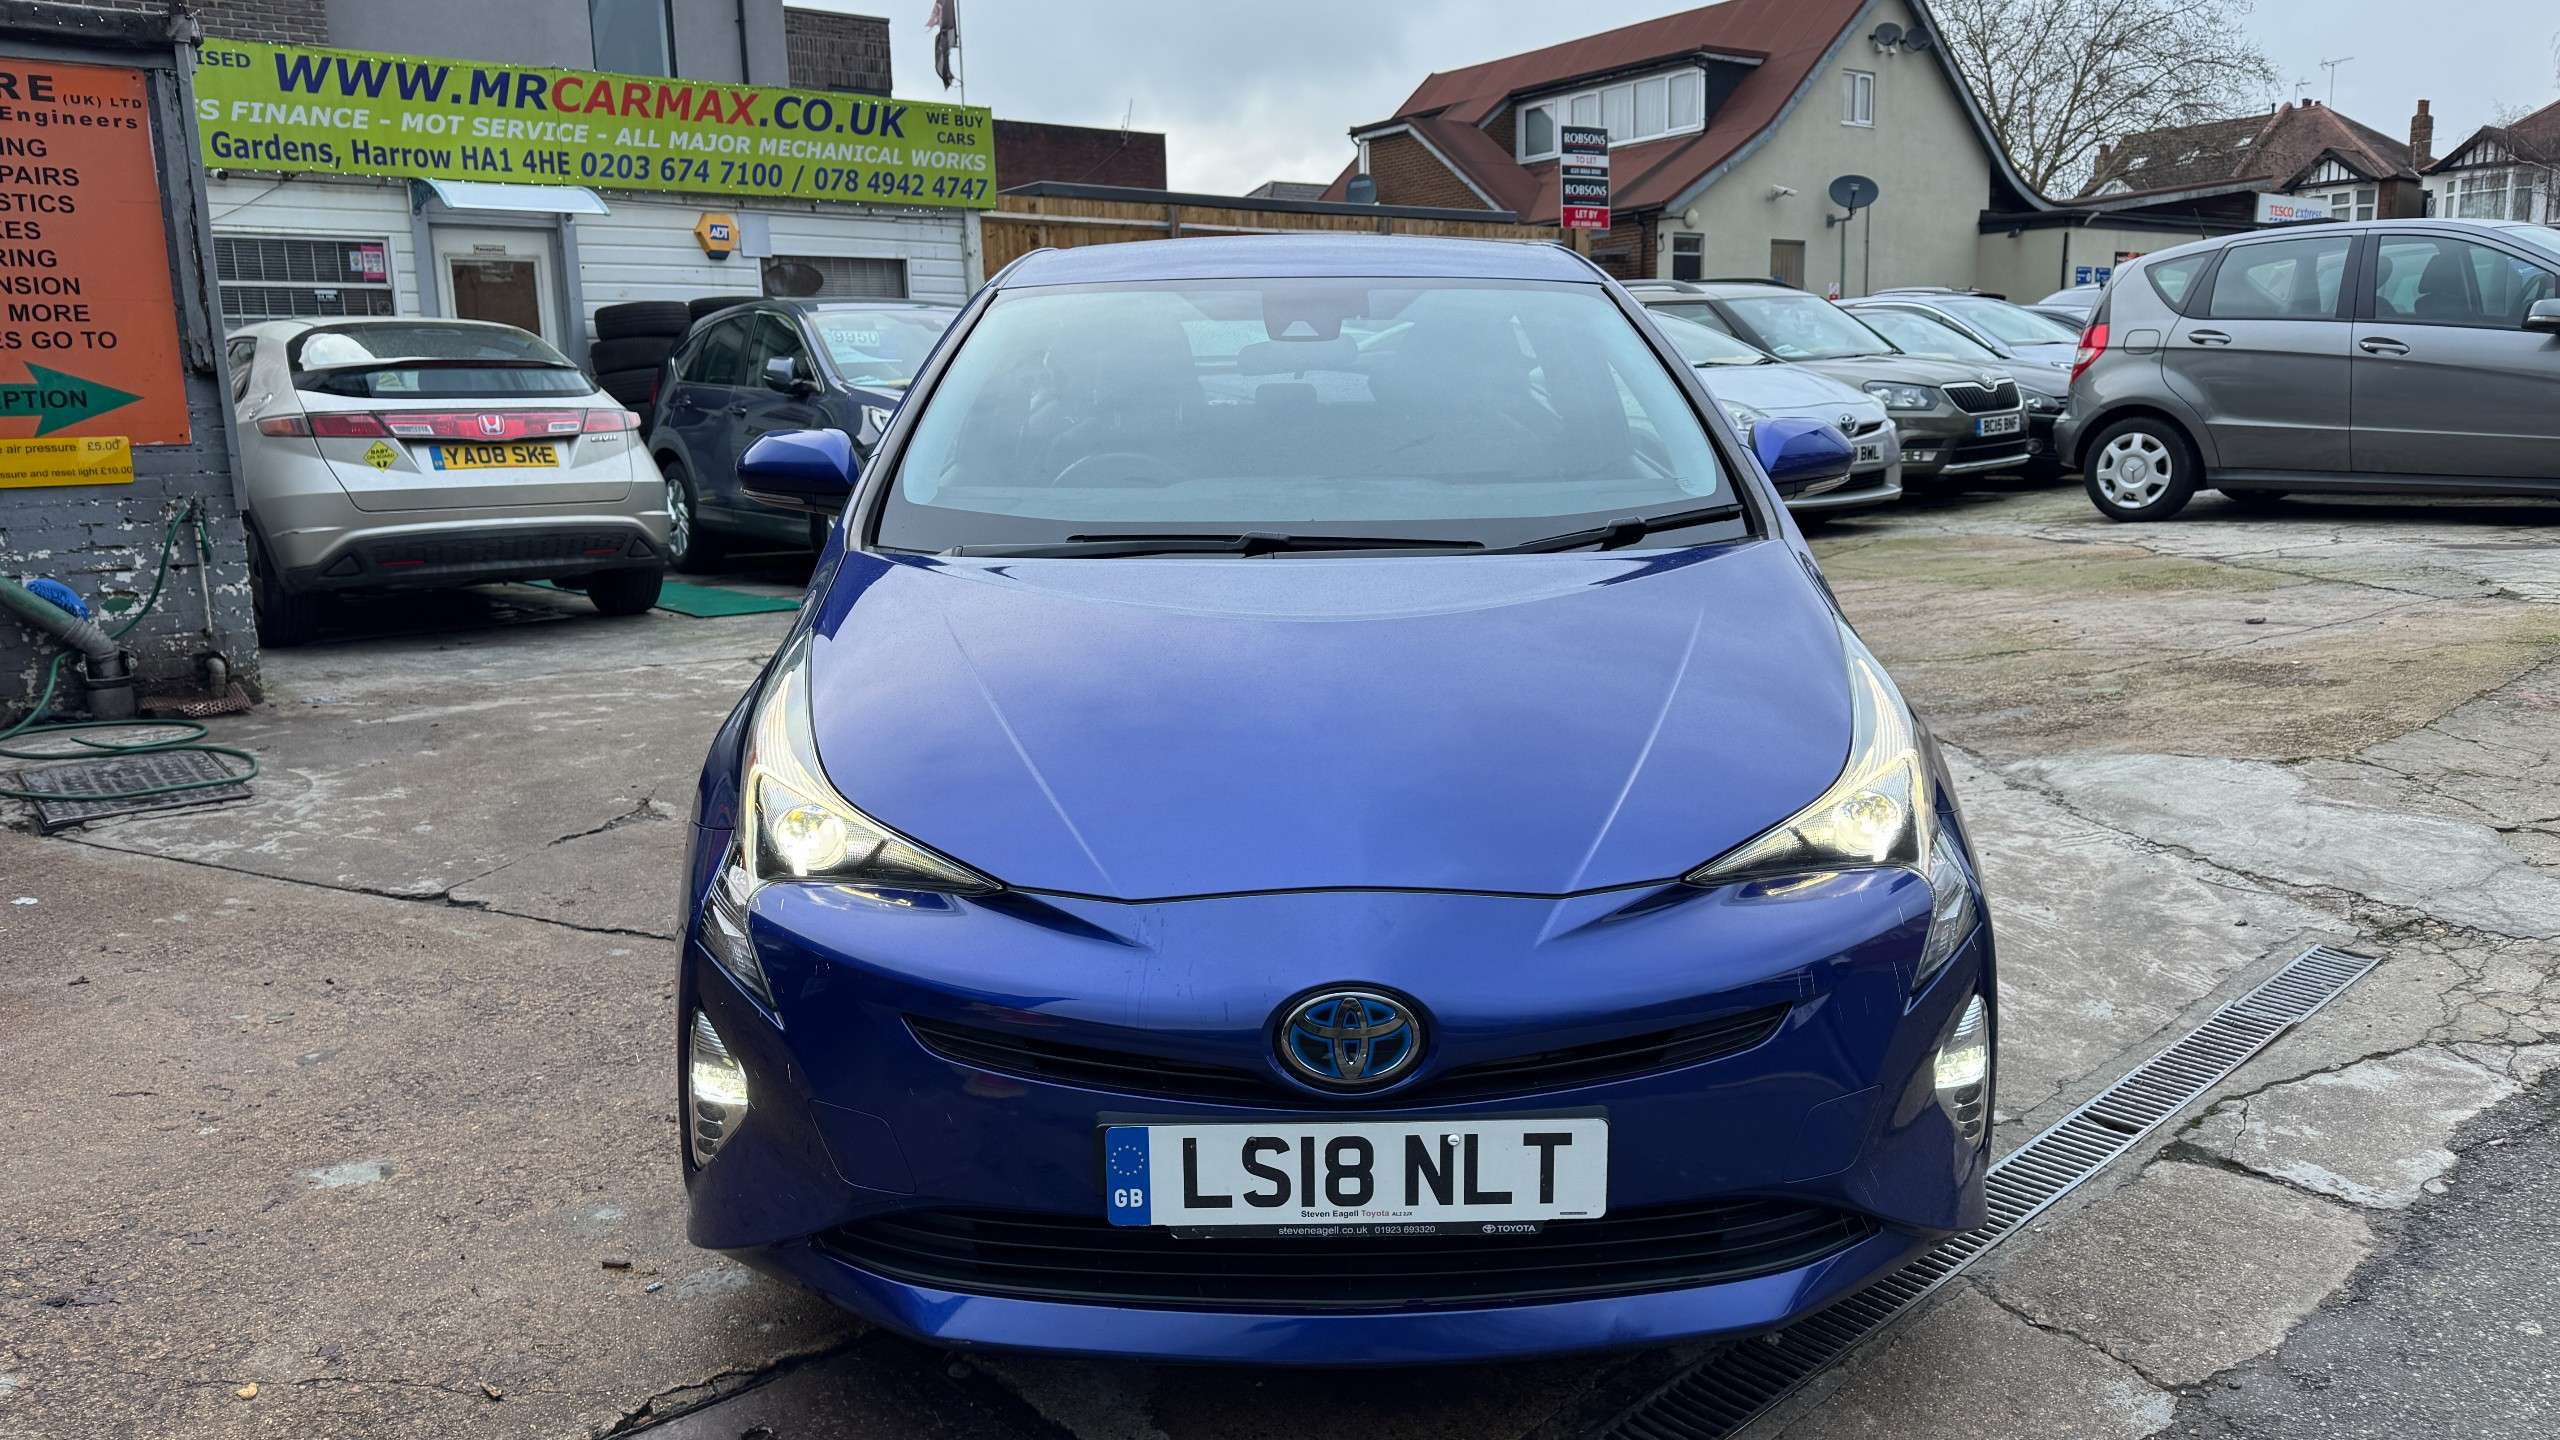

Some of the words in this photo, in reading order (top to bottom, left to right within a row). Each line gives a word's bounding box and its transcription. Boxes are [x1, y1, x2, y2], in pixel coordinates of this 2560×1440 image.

[63, 94, 101, 108] (UK)
[110, 97, 142, 109] LTD
[196, 50, 251, 68] ISED
[275, 53, 909, 138] WWW.MRCARMAX.CO.UK
[0, 106, 138, 129] Engineers
[926, 111, 948, 125] WE
[955, 114, 983, 129] BUY
[230, 101, 369, 129] FINANCE
[401, 111, 464, 135] MOT
[472, 117, 589, 143] SERVICE
[615, 127, 660, 149] ALL
[668, 130, 751, 154] MAJOR
[759, 137, 903, 166] MECHANICAL
[911, 149, 986, 172] WORKS
[937, 131, 976, 146] CARS
[1563, 132, 1606, 145] ROBSONS
[211, 130, 342, 169] Gardens,
[351, 139, 451, 169] Harrow
[461, 145, 512, 173] HA1
[522, 149, 571, 176] 4HE
[580, 151, 650, 180] 0203
[660, 157, 709, 184] 674
[720, 160, 783, 188] 7100
[814, 167, 858, 193] 078
[867, 171, 924, 197] 4942
[932, 175, 988, 200] 4747
[0, 165, 80, 187] PAIRS
[1564, 184, 1607, 196] ROBSONS
[1575, 209, 1588, 219] LET
[1589, 209, 1598, 219] BY
[2271, 204, 2294, 217] TESCO
[710, 226, 728, 239] ADT
[8, 303, 90, 322] MORE
[31, 331, 73, 349] GO
[81, 331, 117, 349] TO
[0, 389, 88, 409] PTION
[6, 444, 21, 454] air
[25, 443, 77, 456] pressure
[445, 446, 507, 466] YA08
[513, 445, 556, 464] SKE
[30, 468, 49, 478] and
[51, 467, 75, 478] reset
[78, 466, 98, 478] light
[101, 464, 133, 476] £10.00
[1182, 1135, 1374, 1209] LS18
[1404, 1132, 1573, 1206] NLT
[1114, 1188, 1143, 1208] GB
[1301, 1209, 1330, 1218] Steven
[1332, 1209, 1359, 1219] Eagell
[1361, 1209, 1390, 1219] Toyota
[1278, 1225, 1368, 1236] steveneagell.co.uk
[1374, 1225, 1401, 1235] 01923
[1403, 1225, 1436, 1234] 693320
[1497, 1223, 1536, 1233] TOYOTA
